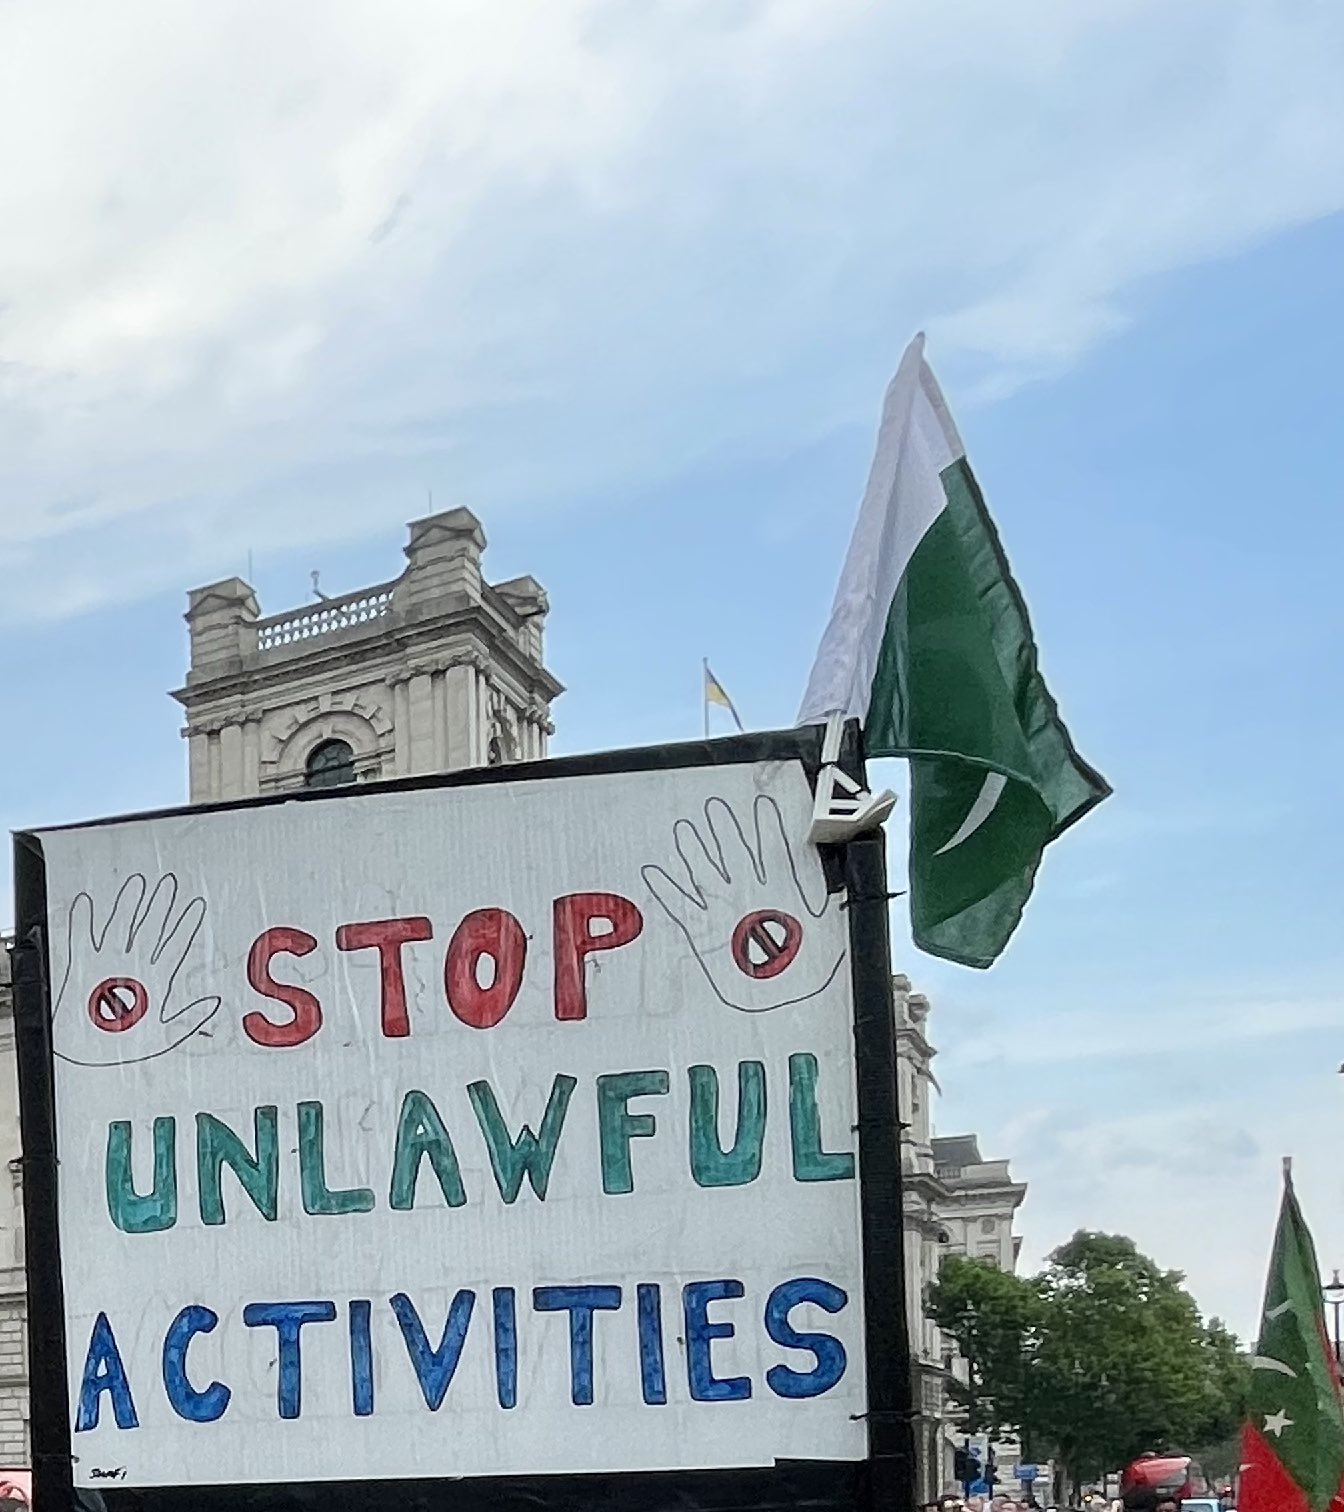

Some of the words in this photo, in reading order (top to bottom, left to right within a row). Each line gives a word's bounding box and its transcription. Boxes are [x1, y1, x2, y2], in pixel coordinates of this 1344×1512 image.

[242, 892, 644, 1047] STOP
[106, 1053, 854, 1233] UNLAWFUL
[74, 1278, 848, 1432] ACTIVITIES
